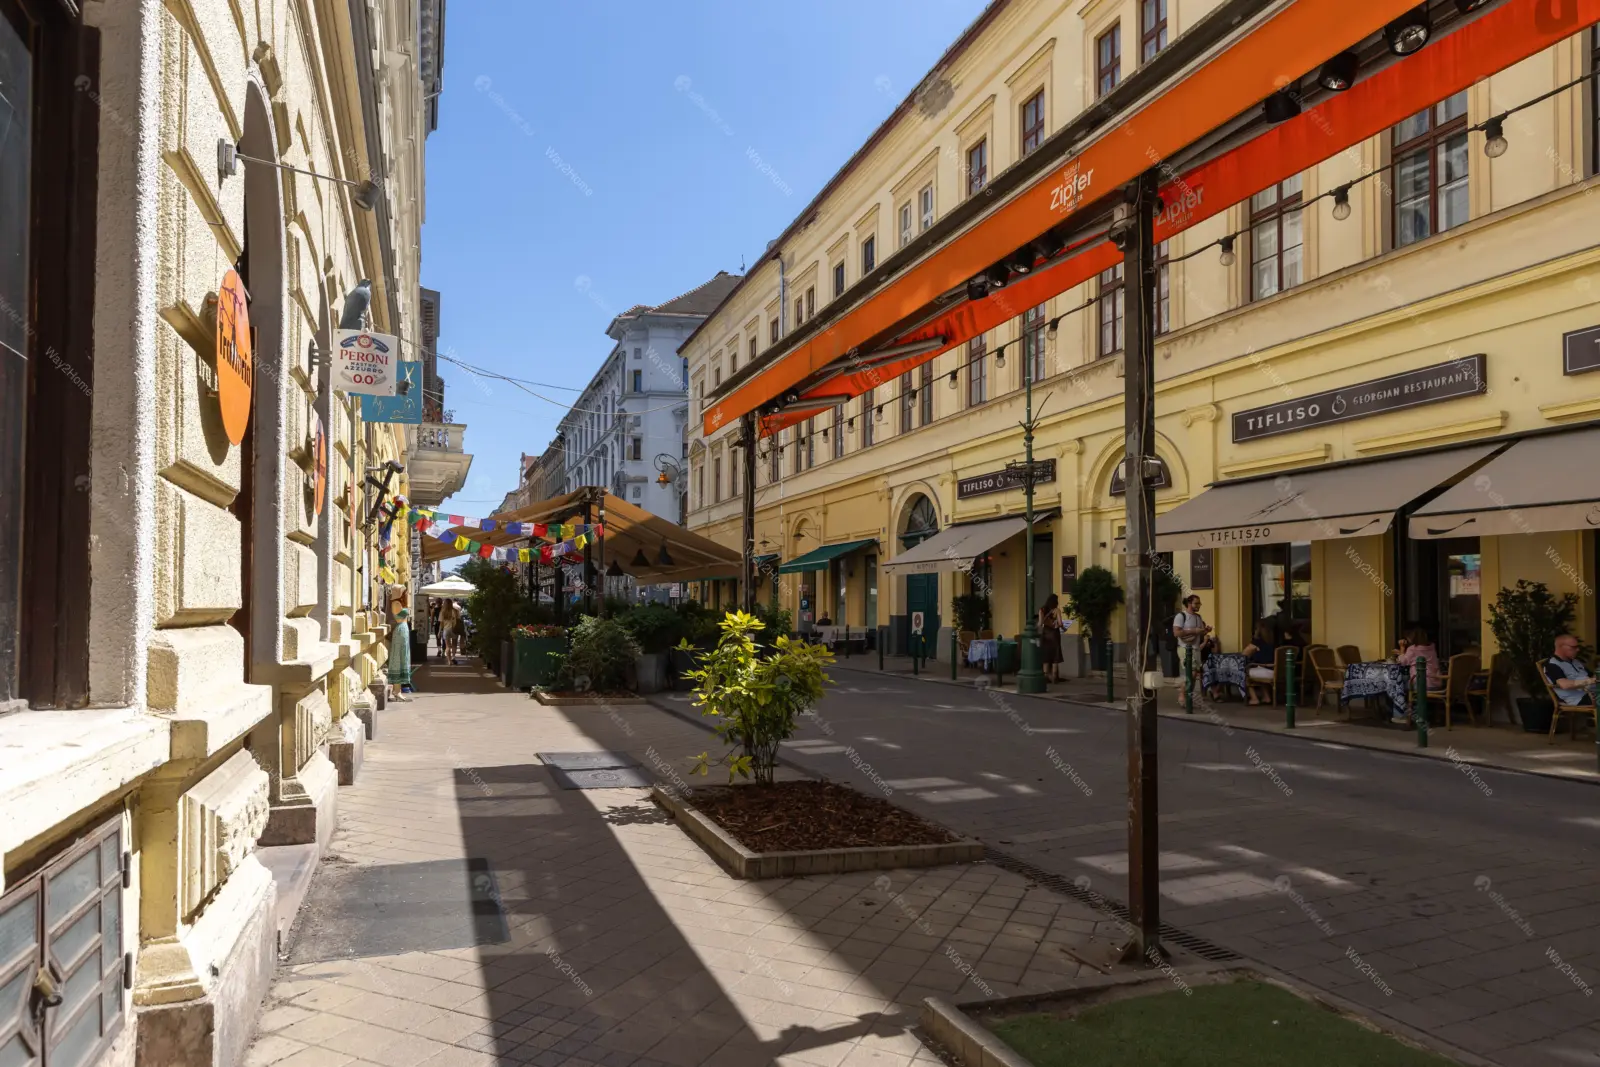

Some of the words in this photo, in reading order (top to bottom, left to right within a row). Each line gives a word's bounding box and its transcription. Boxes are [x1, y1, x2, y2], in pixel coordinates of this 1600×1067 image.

[1050, 168, 1094, 211] Zipfer
[339, 349, 389, 366] PERONI
[344, 365, 384, 374] AZZURRO
[1246, 403, 1320, 431] TIFLISO
[1352, 386, 1400, 406] GEORGIAN
[1404, 371, 1470, 395] RESTAURANT
[962, 479, 994, 493] TIFLISO
[1210, 527, 1271, 542] TIFLISZO
